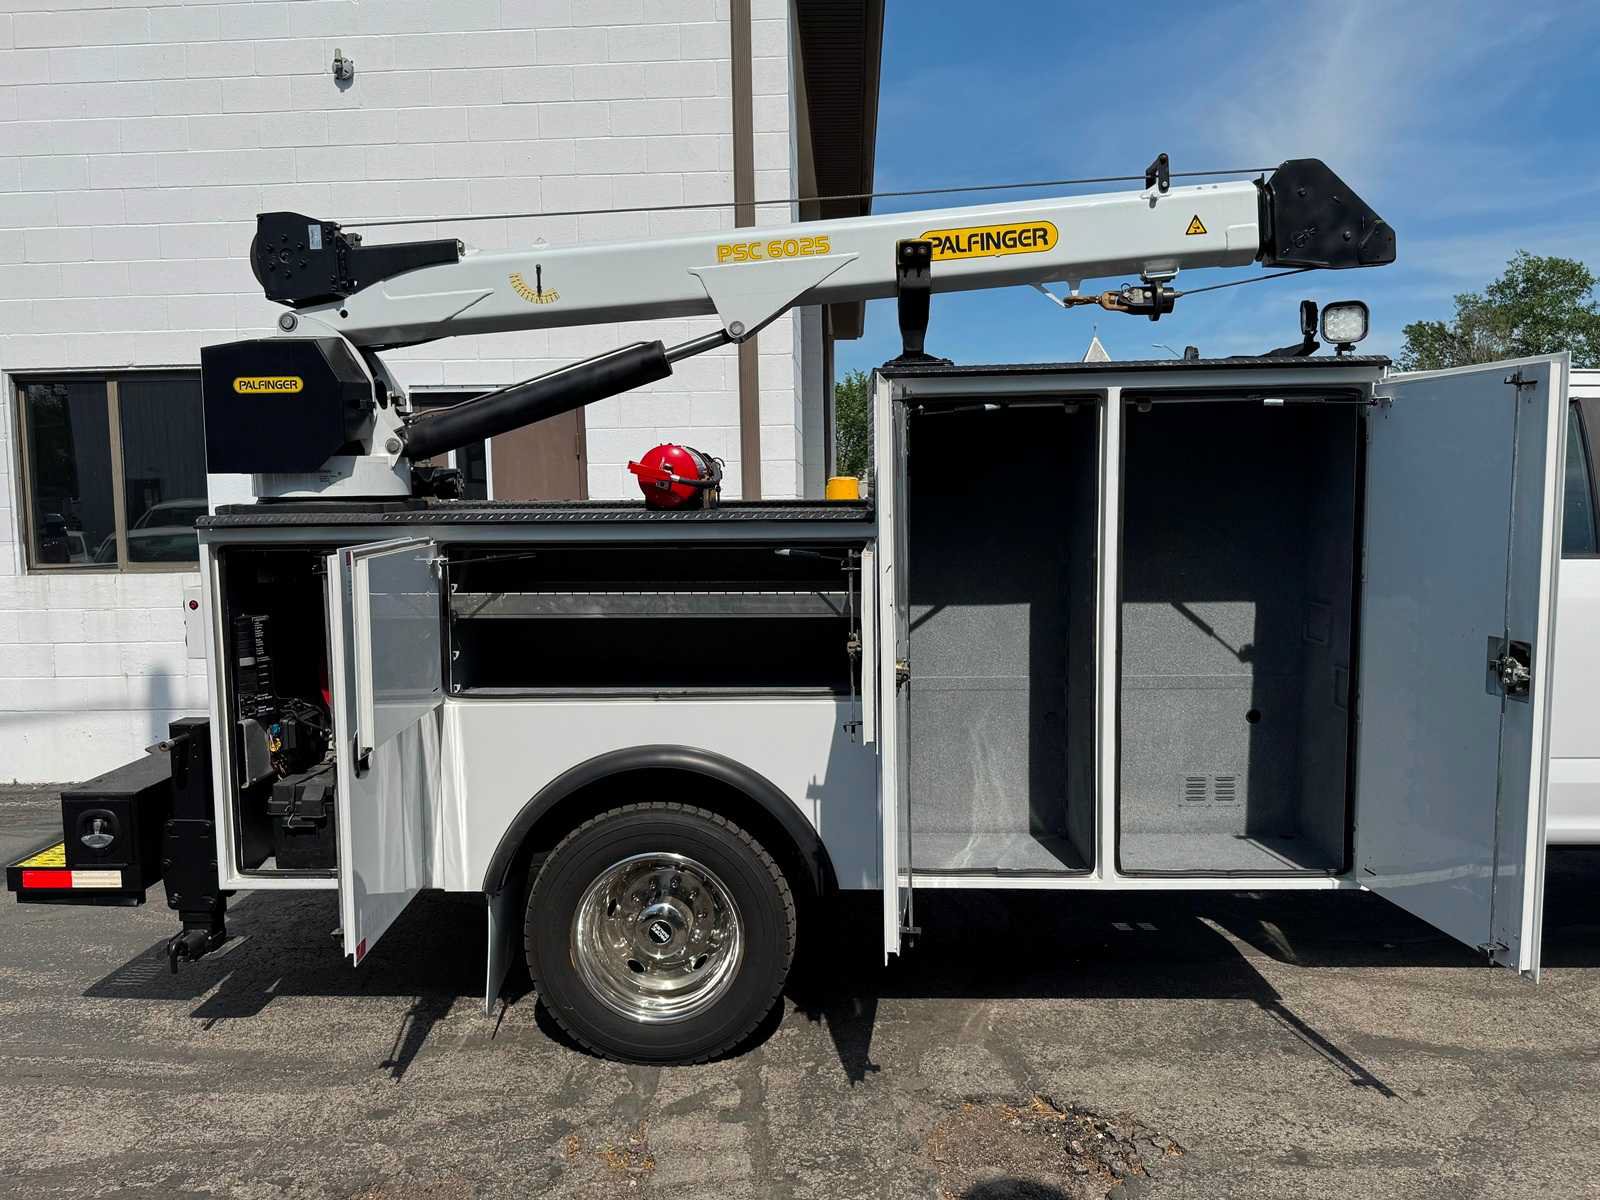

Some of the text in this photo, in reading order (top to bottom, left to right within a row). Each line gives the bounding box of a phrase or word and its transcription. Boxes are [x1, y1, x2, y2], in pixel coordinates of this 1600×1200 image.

[717, 235, 831, 263] PSC 6025
[926, 227, 1049, 255] PALFINGER
[239, 380, 298, 390] PALFINGER
